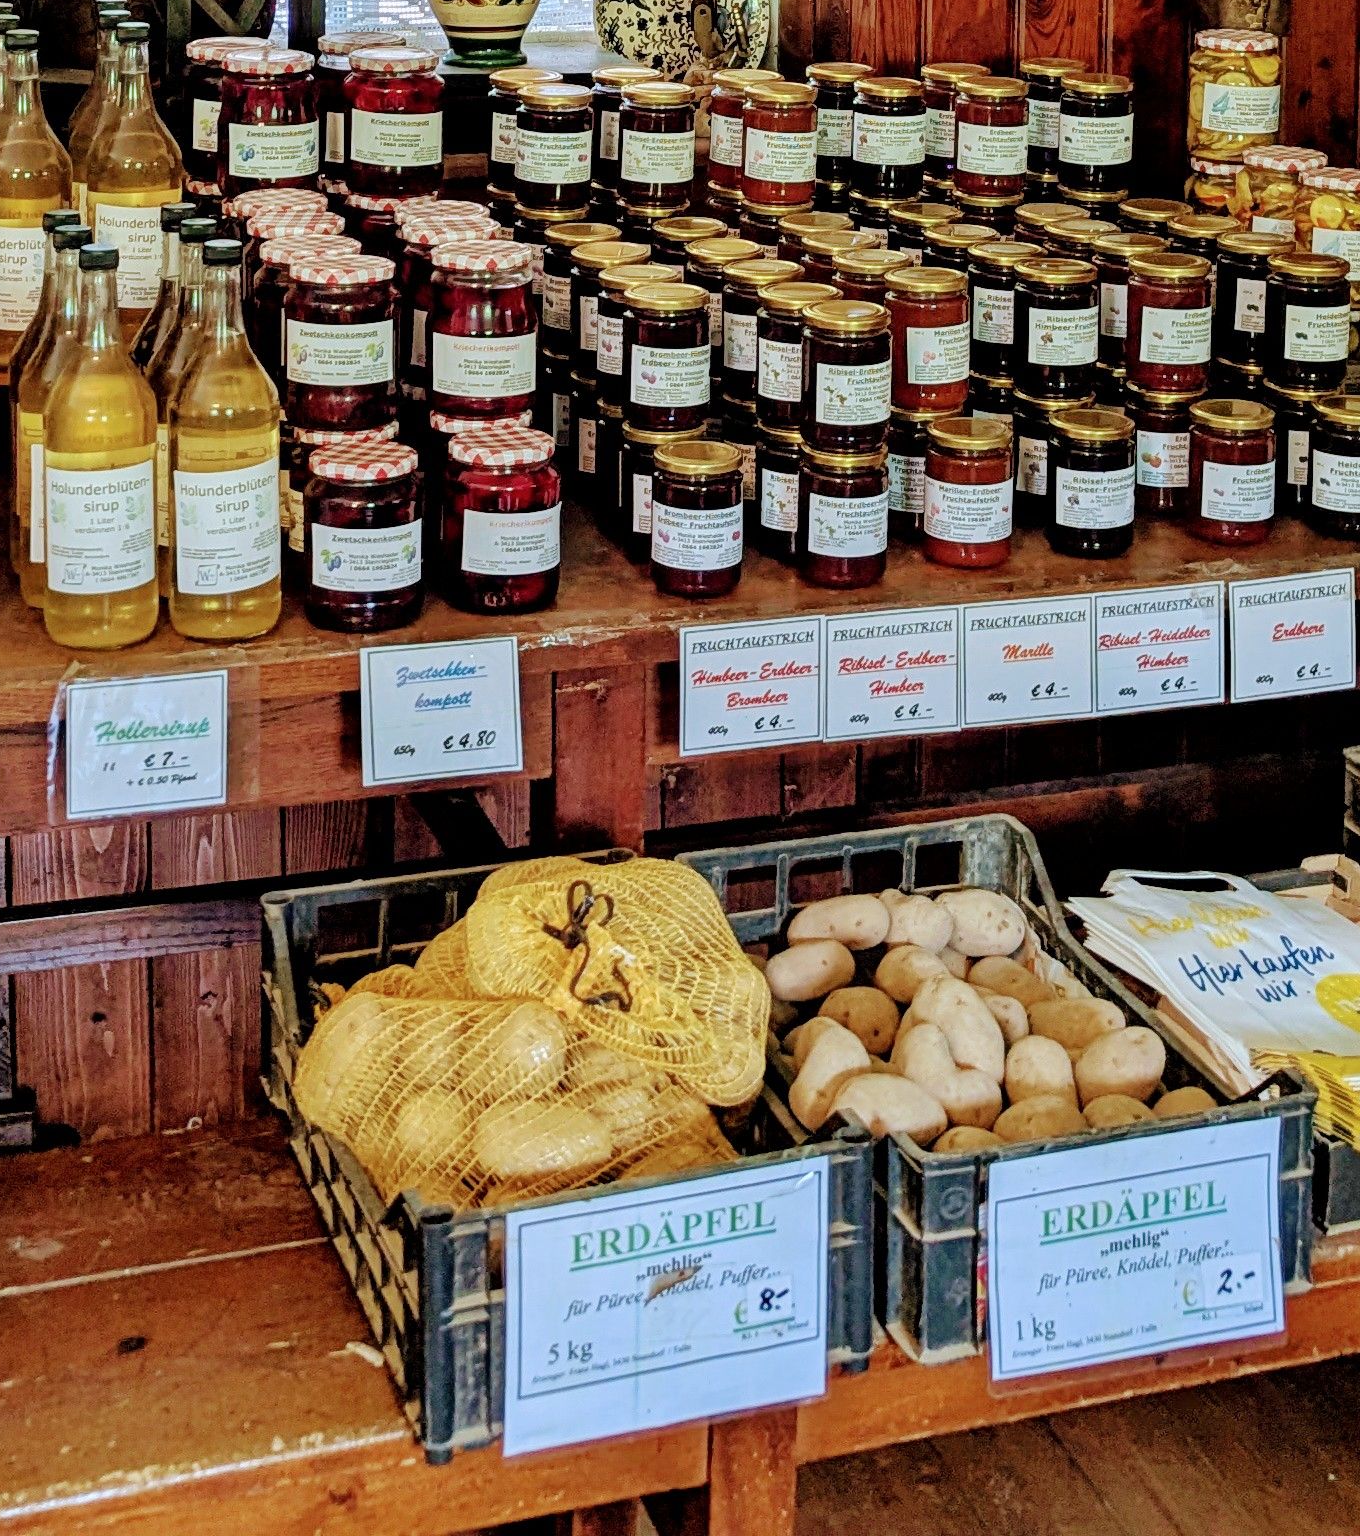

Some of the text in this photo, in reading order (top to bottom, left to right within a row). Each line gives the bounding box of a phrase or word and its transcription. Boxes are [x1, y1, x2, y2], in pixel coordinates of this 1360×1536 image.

[127, 233, 157, 244] sirup
[51, 477, 151, 497] Holunderblüten-
[180, 474, 276, 497] Holunderblüten-
[83, 499, 120, 514] sirup
[215, 498, 250, 514] sirup
[1239, 582, 1347, 608] FRUCHTAUFSTRICH
[1102, 595, 1215, 618] FRUCHTAUFSTRICH
[833, 619, 954, 642] FRUCHTAUFSTRICH
[970, 610, 1087, 632] FRUCHTAUFSTRICH
[1272, 621, 1326, 641] Erdbeere
[691, 630, 815, 654] FRUCHTAUFSTRICH
[1002, 642, 1054, 660] Marille
[1136, 651, 1189, 669] Himbeer
[396, 661, 487, 688] Zwetschken-
[1296, 665, 1306, 678] €
[869, 679, 925, 696] Himbeer
[1031, 684, 1041, 697] €
[1160, 678, 1170, 691] €
[414, 691, 473, 710] kompott
[726, 691, 789, 708] Brombeer
[894, 705, 904, 718] €
[94, 716, 211, 743] Hollersirup
[754, 716, 764, 730] €
[394, 735, 455, 756] 650g €
[144, 751, 189, 768] € 7.-
[171, 772, 198, 785] Pfand
[1178, 935, 1336, 996] Hier kaufen
[1256, 978, 1298, 1003] wir
[1039, 1179, 1227, 1238] ERDÄPFEL
[569, 1199, 777, 1264] ERDÄPFEL
[1036, 1252, 1172, 1296] für Püree, Knödel,
[1182, 1267, 1256, 1307] € 2.-
[563, 1299, 592, 1322] für
[1031, 1314, 1057, 1340] kg
[547, 1342, 560, 1365] 5
[567, 1337, 594, 1363] kg
